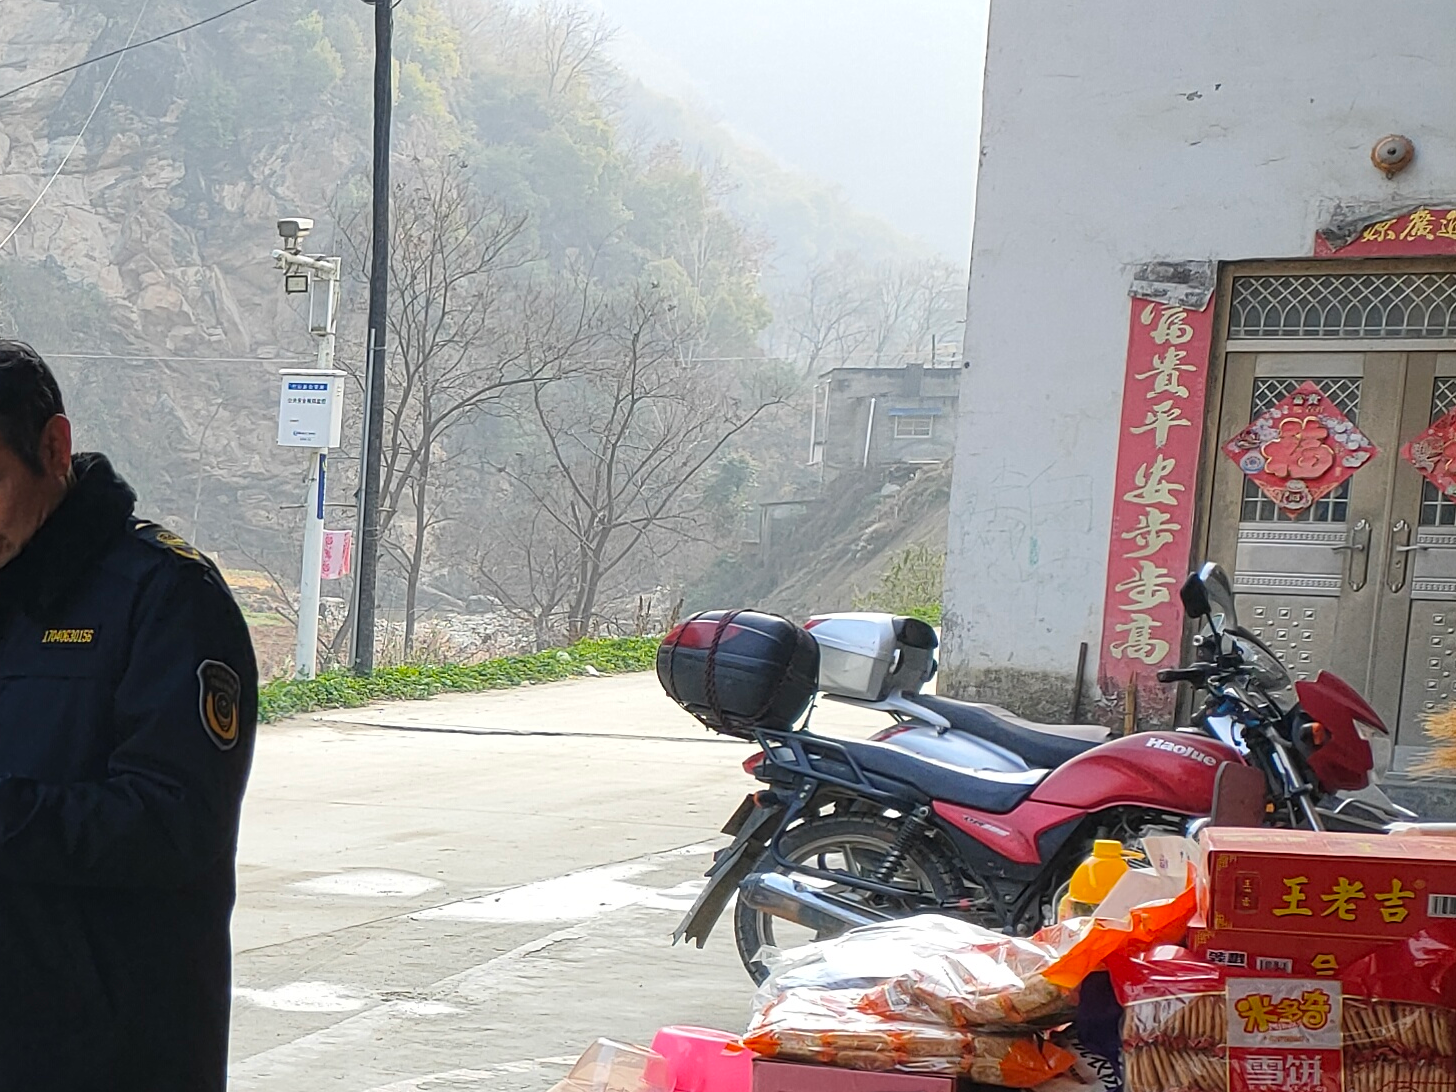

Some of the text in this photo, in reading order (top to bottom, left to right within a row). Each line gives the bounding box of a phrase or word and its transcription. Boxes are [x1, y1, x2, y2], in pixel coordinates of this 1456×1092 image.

[1272, 876, 1415, 923] 王老吉
[1235, 988, 1331, 1033] 米多奇
[1244, 1054, 1324, 1089] 雪饼
